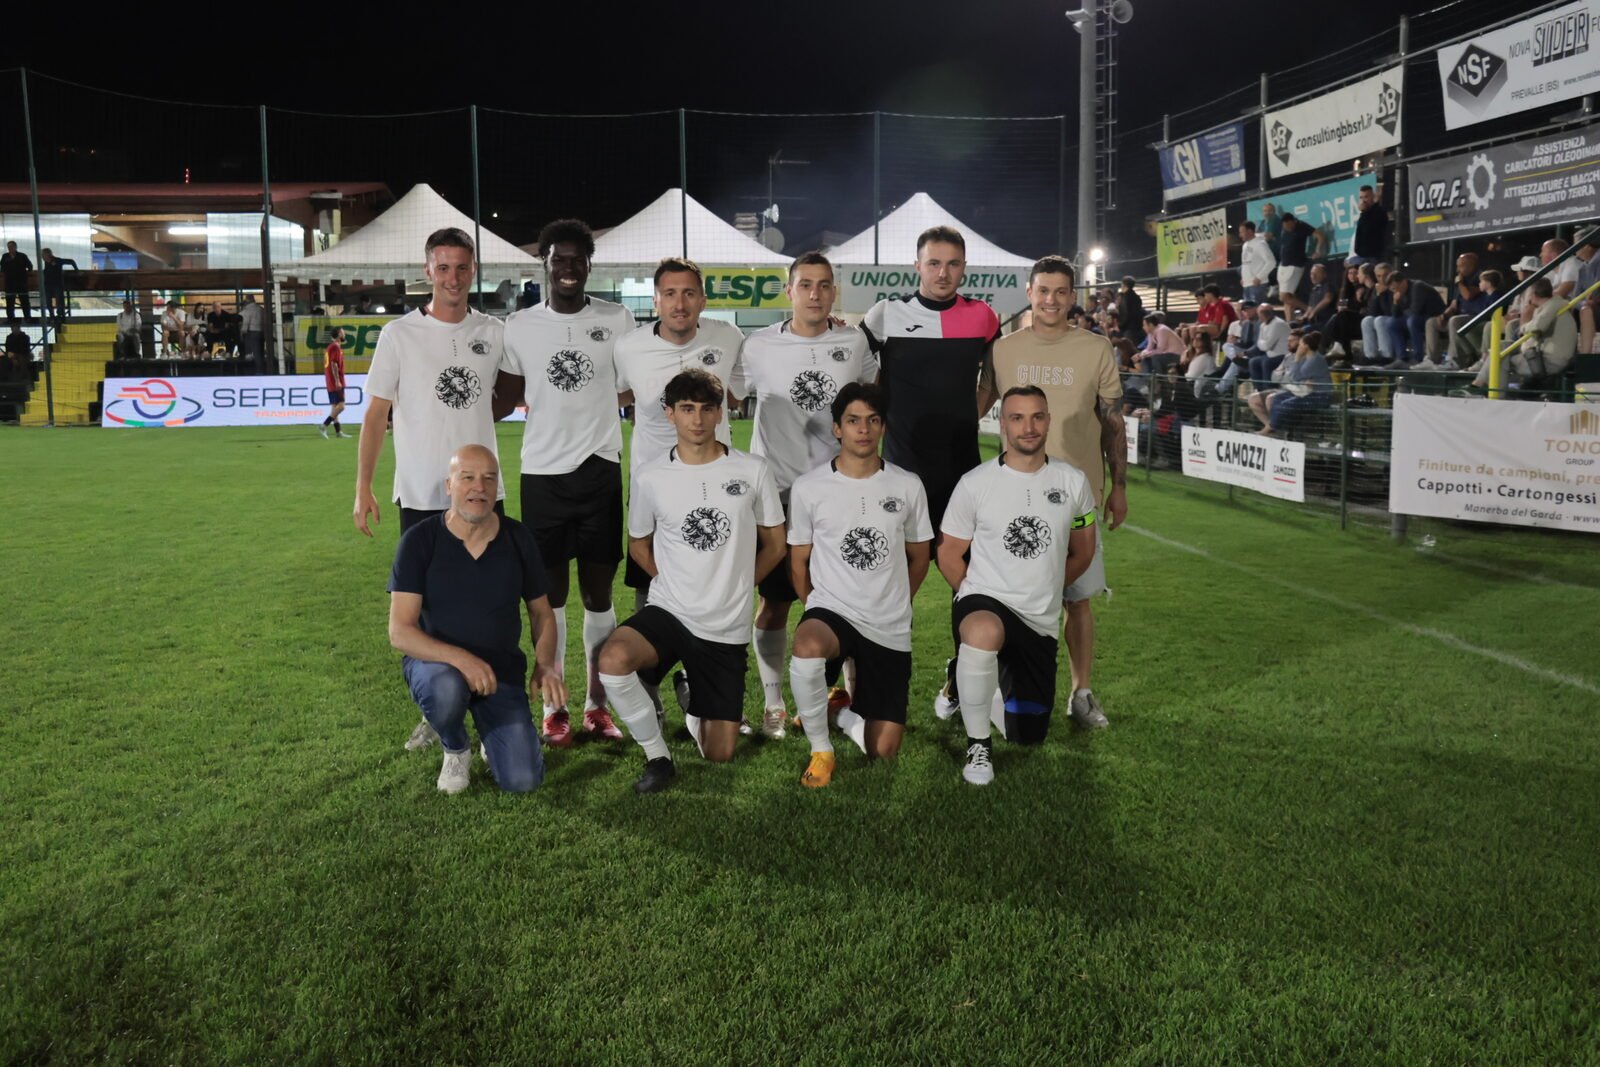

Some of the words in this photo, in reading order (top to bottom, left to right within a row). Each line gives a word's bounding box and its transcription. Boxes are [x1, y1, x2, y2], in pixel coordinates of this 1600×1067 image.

[1509, 39, 1531, 59] NOVA
[1458, 53, 1491, 86] NSF
[1511, 83, 1545, 101] PREVALLE
[1295, 113, 1373, 149] consultingbbsrl.it
[1532, 136, 1586, 156] ASSISTENZA
[1505, 154, 1552, 174] CARICATORI
[1504, 178, 1562, 198] ATTREZZATURE
[1521, 190, 1566, 209] MOVIMENTO
[1567, 184, 1595, 200] TERRA
[1163, 217, 1225, 246] Ferramenta
[851, 271, 921, 287] UNION
[958, 273, 1018, 289] ORTIVA
[705, 275, 781, 307] usp
[1017, 364, 1075, 386] GUESS
[254, 409, 324, 418] TRASPORTI
[1216, 440, 1267, 472] CAMOZZI
[1565, 457, 1595, 466] GROUP
[1273, 464, 1297, 477] CAMOZZI
[1418, 458, 1472, 474] Finiture
[1476, 463, 1494, 476] da
[1499, 465, 1571, 484] campioni,
[1417, 478, 1483, 495] Cappotti
[1497, 484, 1597, 505] Cartongessi
[1464, 503, 1509, 516] Manerba
[1511, 507, 1528, 518] del
[1530, 509, 1562, 521] Garda
